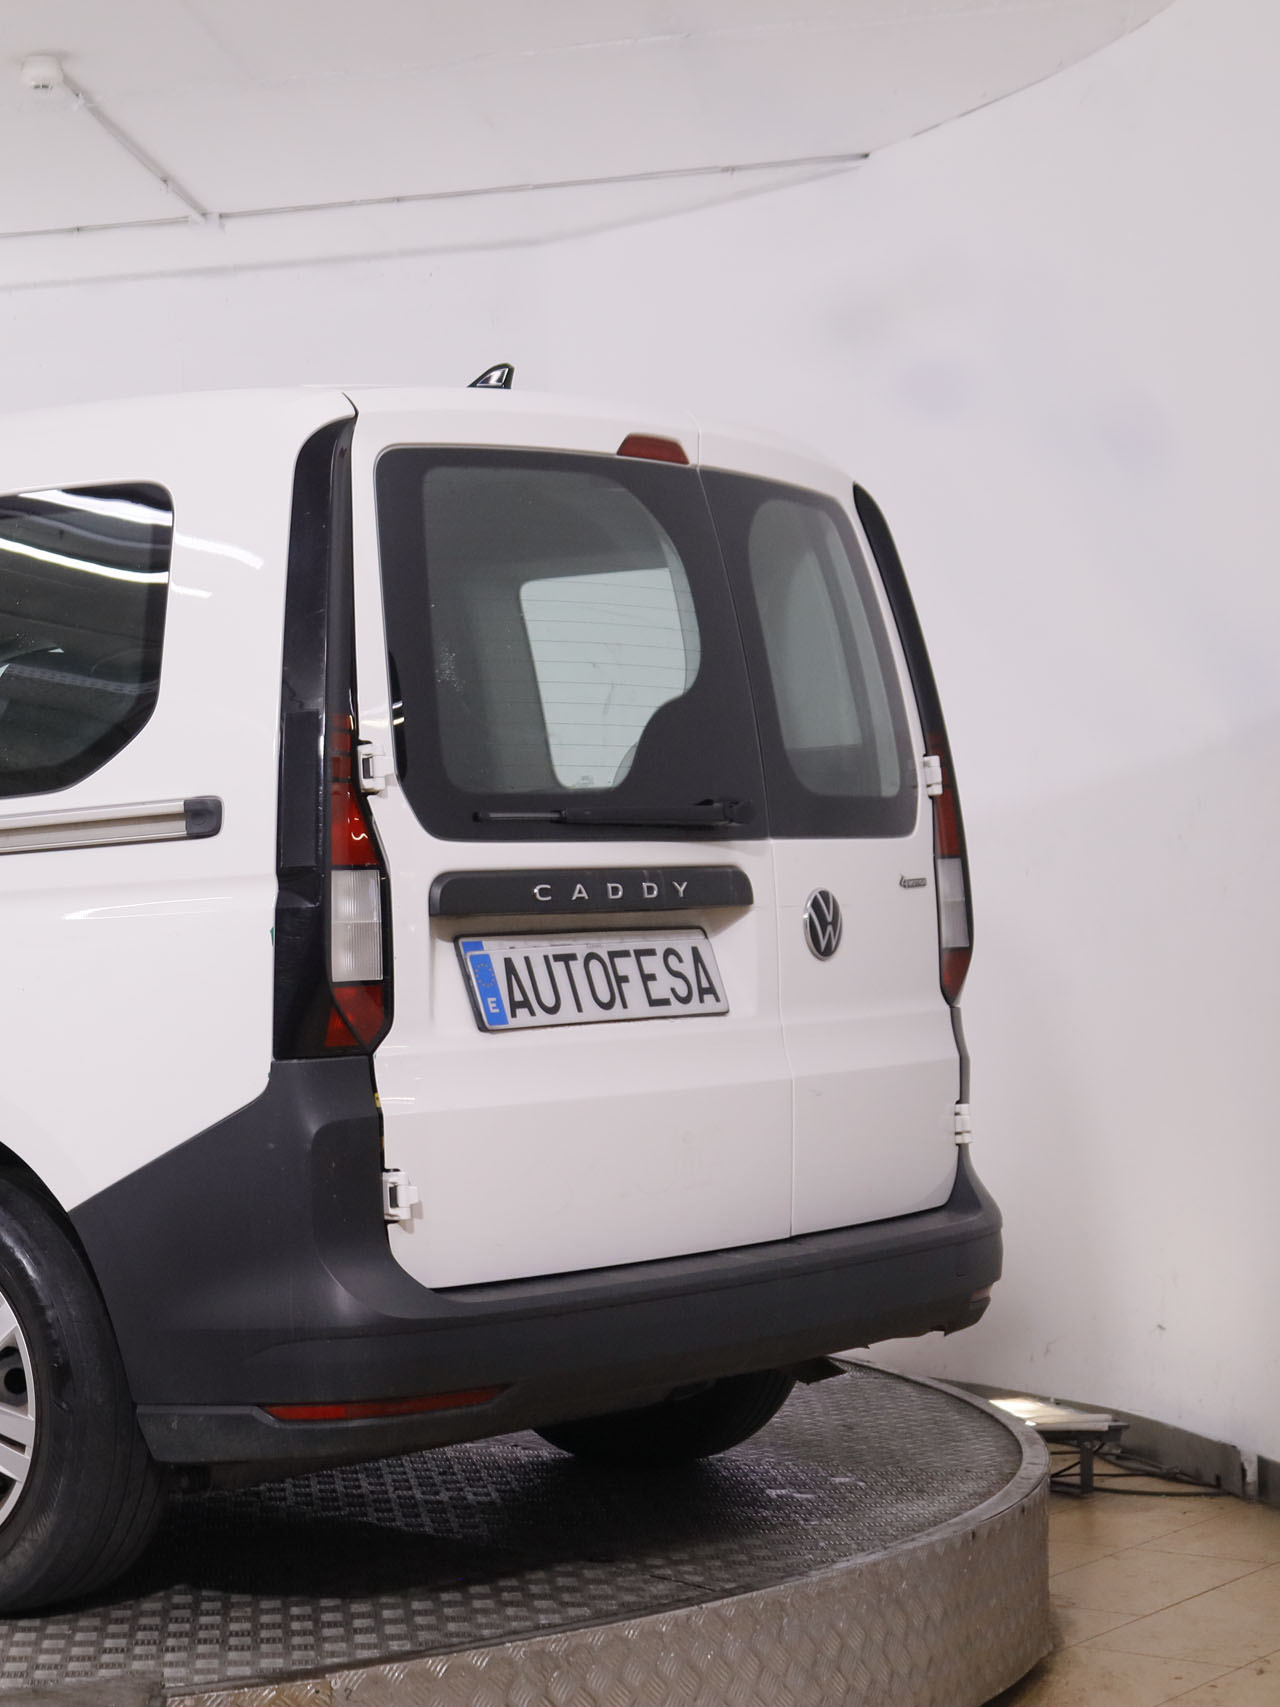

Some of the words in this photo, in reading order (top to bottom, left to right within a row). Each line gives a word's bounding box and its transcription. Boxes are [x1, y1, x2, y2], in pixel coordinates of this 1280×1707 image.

[534, 881, 689, 901] CADDY
[504, 946, 721, 1018] AUTOFESA
[487, 997, 500, 1013] E
